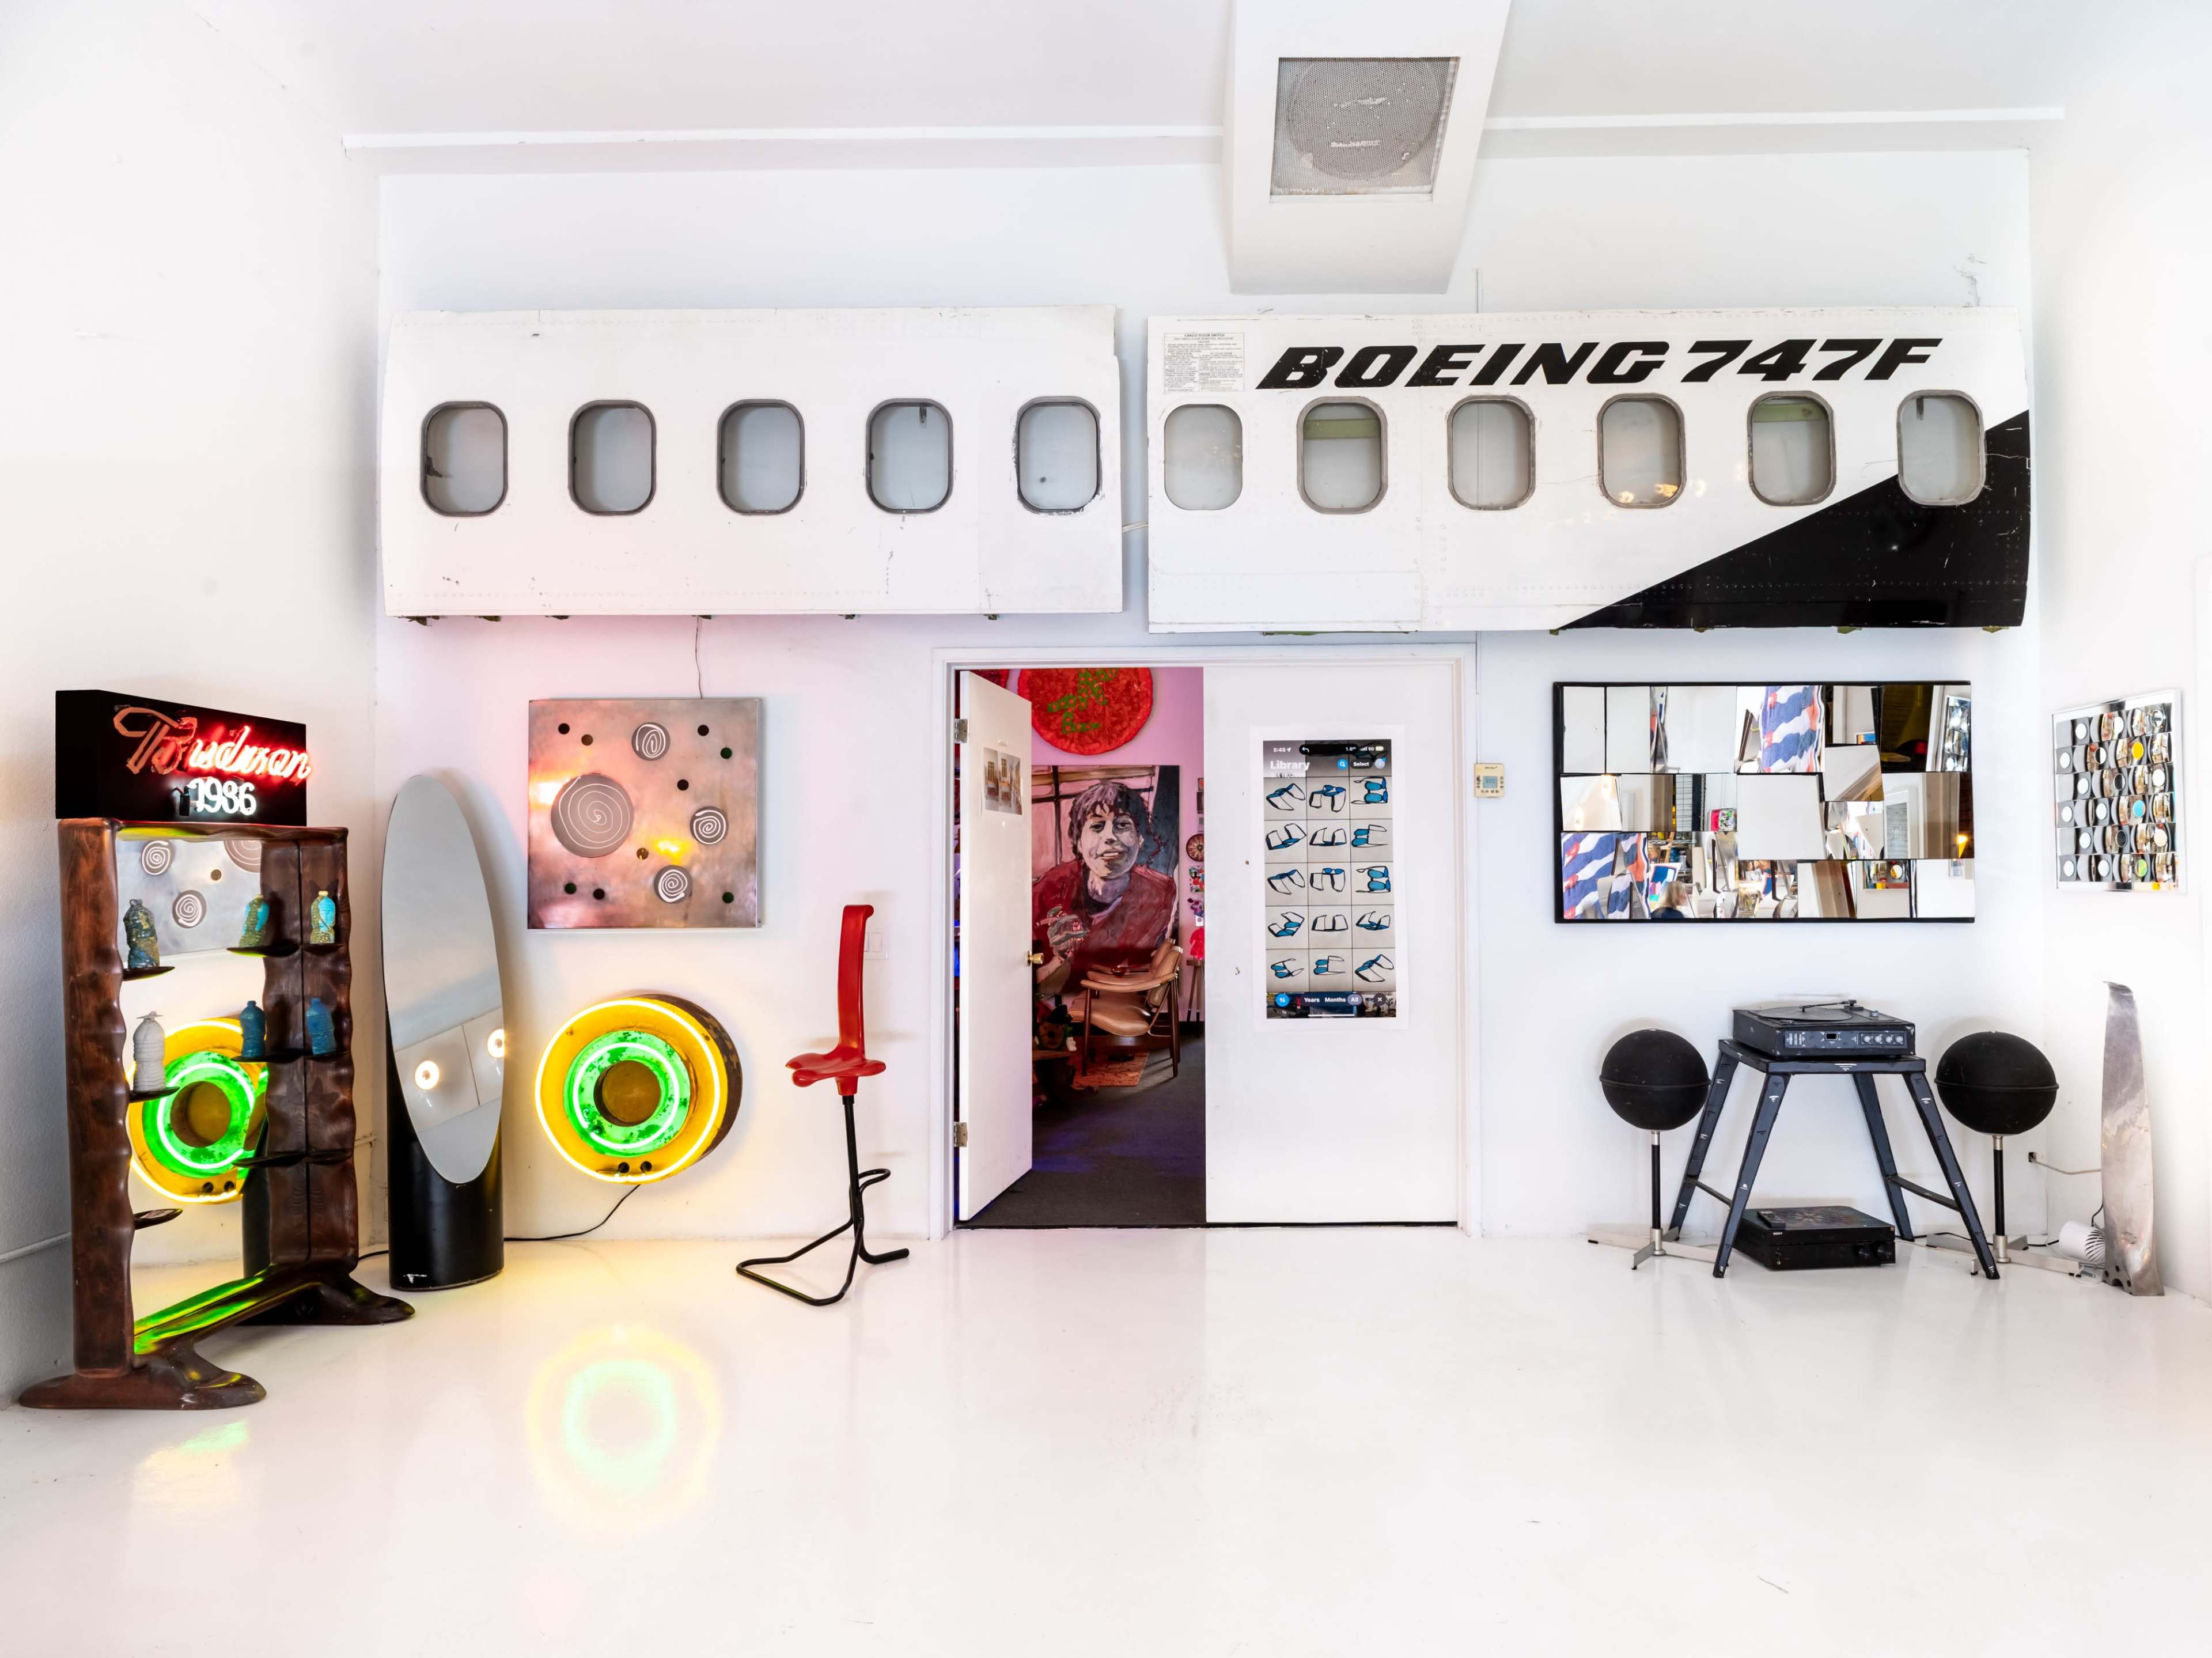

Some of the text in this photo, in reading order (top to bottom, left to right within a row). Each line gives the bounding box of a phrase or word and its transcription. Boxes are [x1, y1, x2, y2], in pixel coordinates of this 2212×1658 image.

[1255, 341, 1669, 389] BOEING
[1680, 338, 1943, 383] 747F
[1270, 760, 1310, 771] Library
[187, 776, 257, 815] 1986
